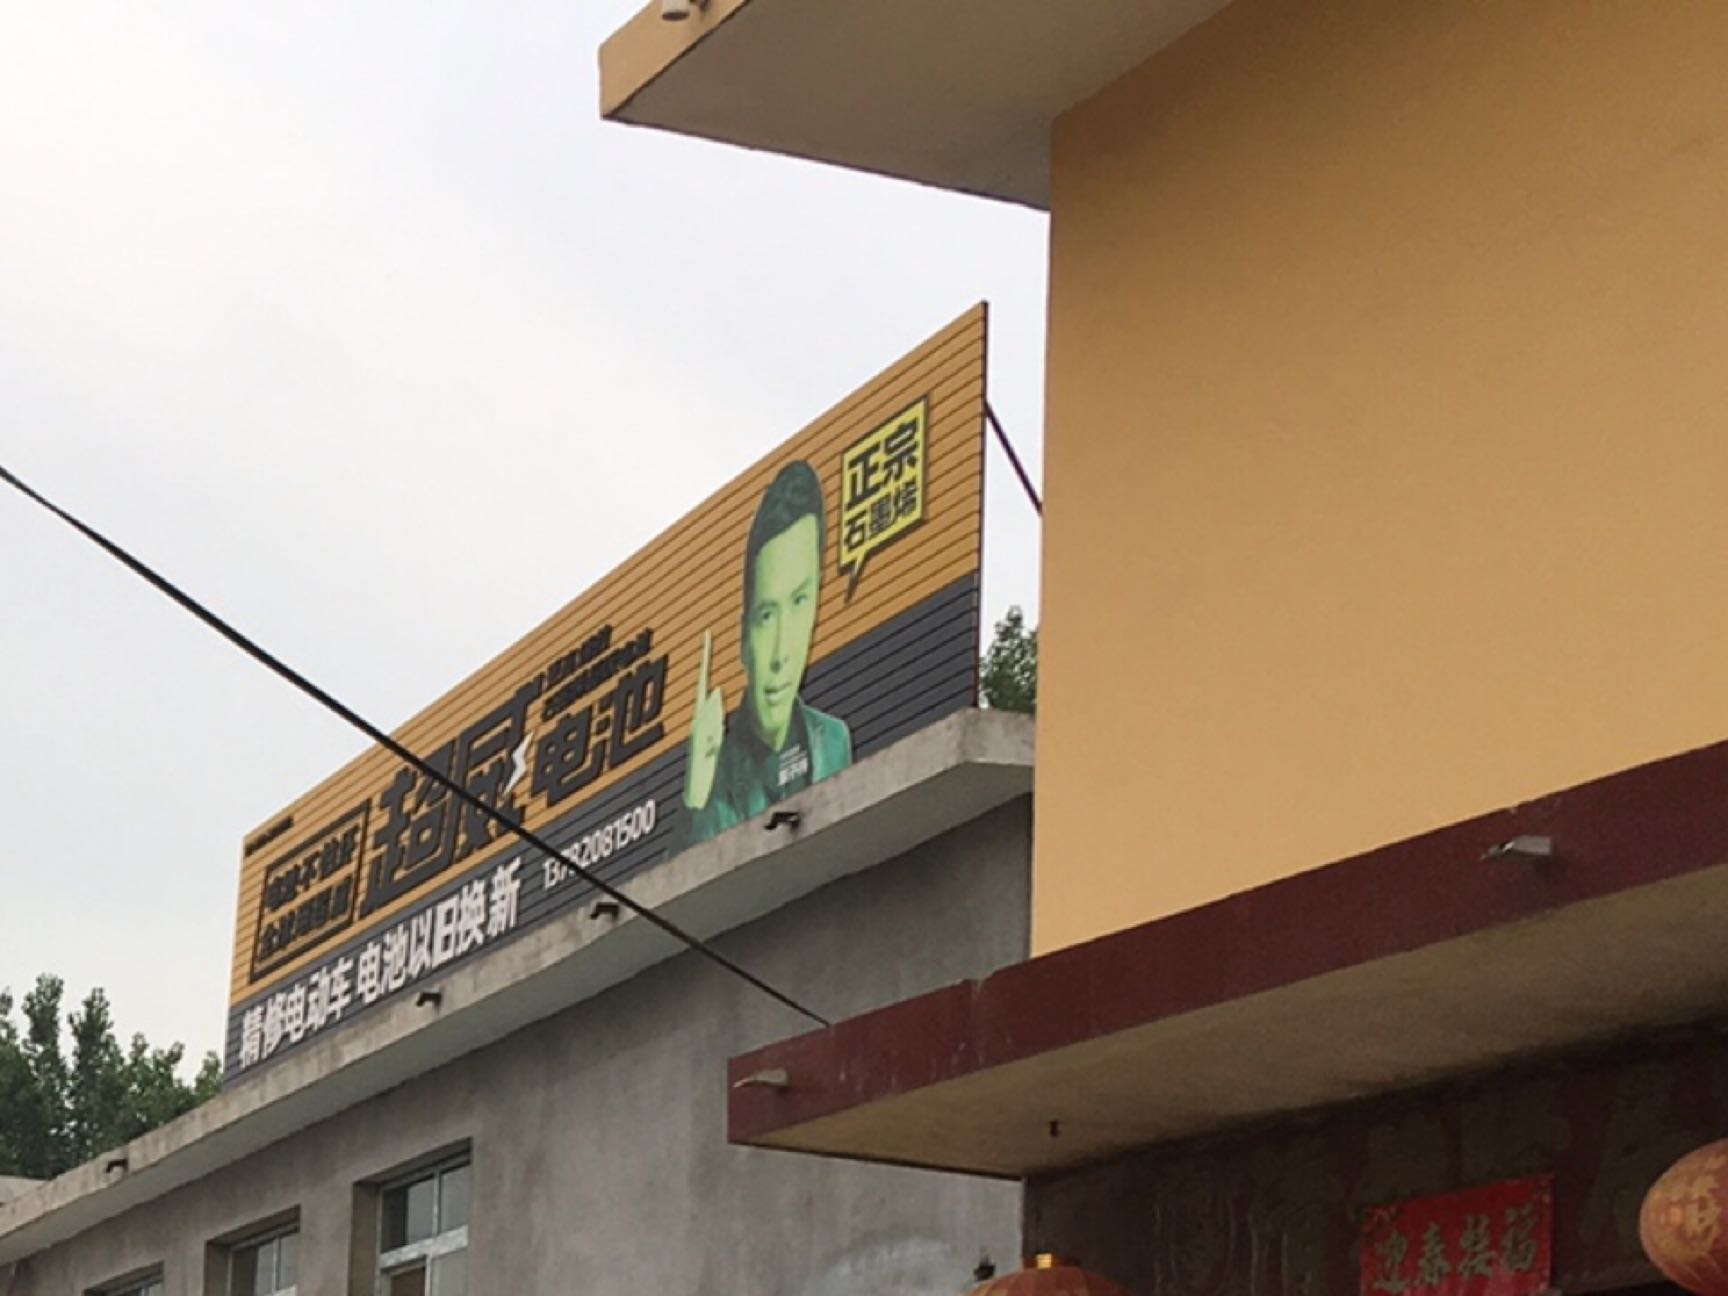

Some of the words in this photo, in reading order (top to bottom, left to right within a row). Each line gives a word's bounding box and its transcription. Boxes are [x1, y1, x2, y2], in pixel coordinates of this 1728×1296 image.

[845, 417, 919, 511] 正宗
[843, 479, 918, 551] 石墨烯
[355, 858, 523, 1004] 电池以旧换新
[1372, 1202, 1538, 1295] 迎春接福
